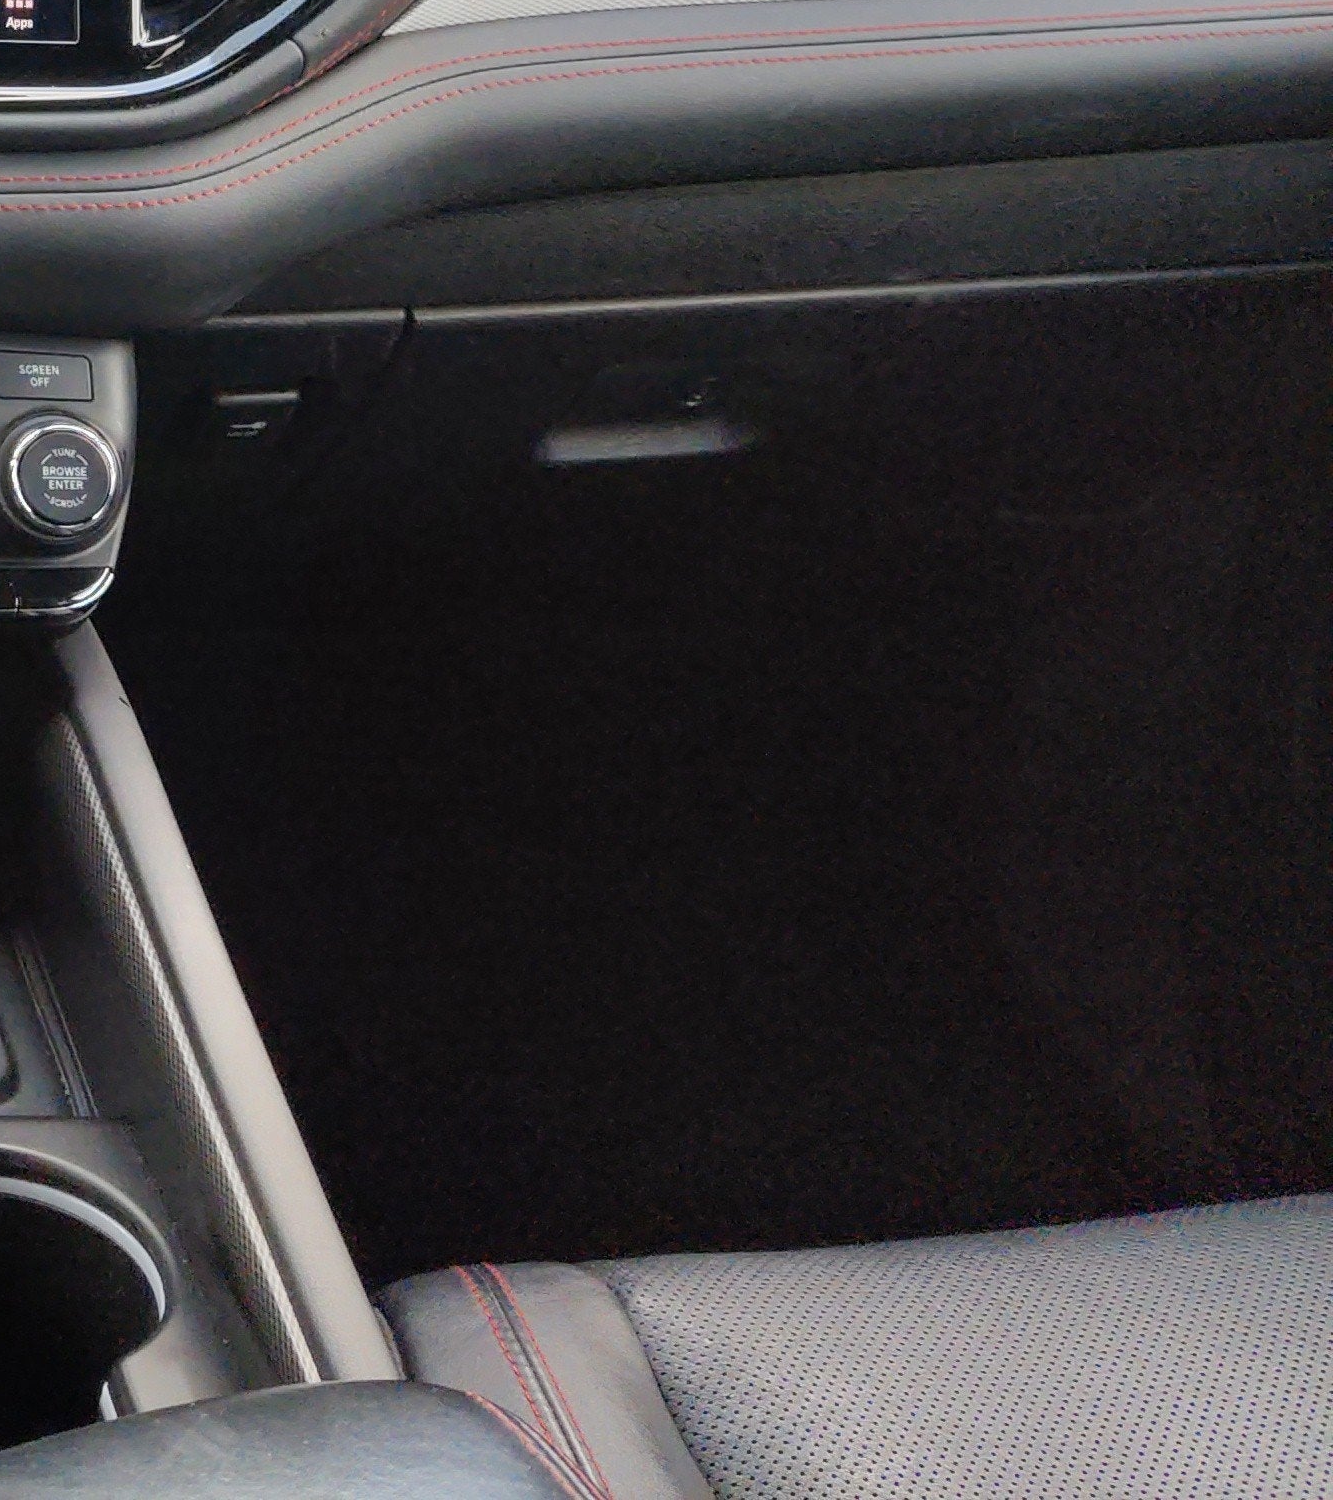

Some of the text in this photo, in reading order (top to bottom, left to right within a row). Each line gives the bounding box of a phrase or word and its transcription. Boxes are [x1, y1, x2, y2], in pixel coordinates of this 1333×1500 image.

[5, 16, 34, 30] Apps
[18, 364, 60, 375] SCREEN
[30, 376, 50, 388] OFF
[42, 465, 87, 477] BROWSE
[48, 479, 84, 491] ENTER
